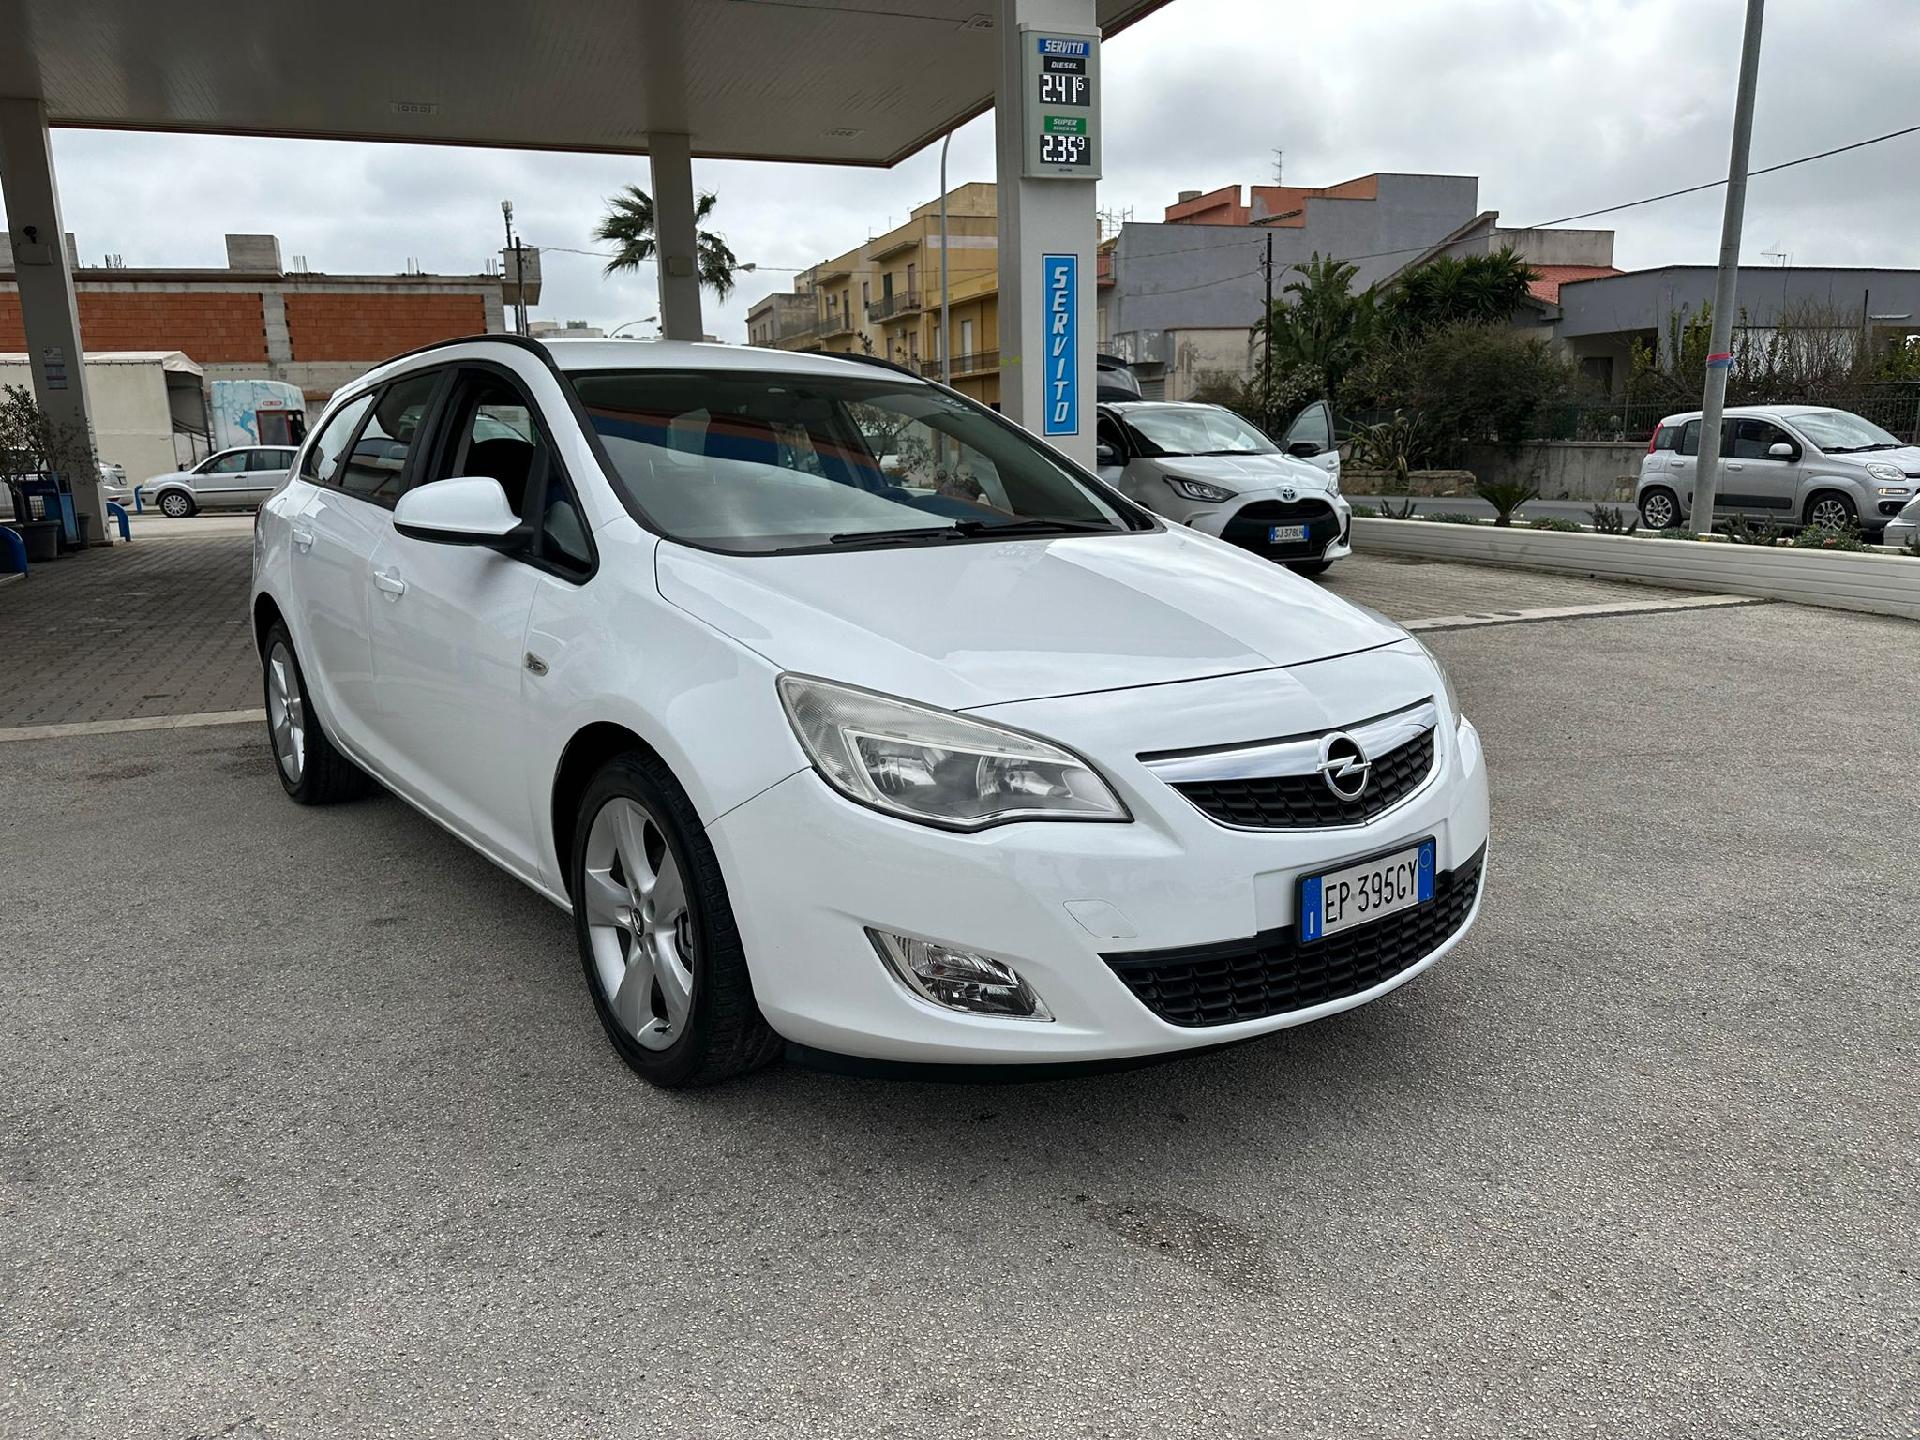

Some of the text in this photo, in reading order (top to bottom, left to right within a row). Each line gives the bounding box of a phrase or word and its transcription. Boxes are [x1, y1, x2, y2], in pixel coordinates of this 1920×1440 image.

[1044, 40, 1084, 54] SERVITO
[1051, 61, 1078, 69] DIESEL
[1053, 118, 1078, 126] SUPER
[1051, 266, 1069, 424] SERVITO
[1325, 881, 1350, 924] EP
